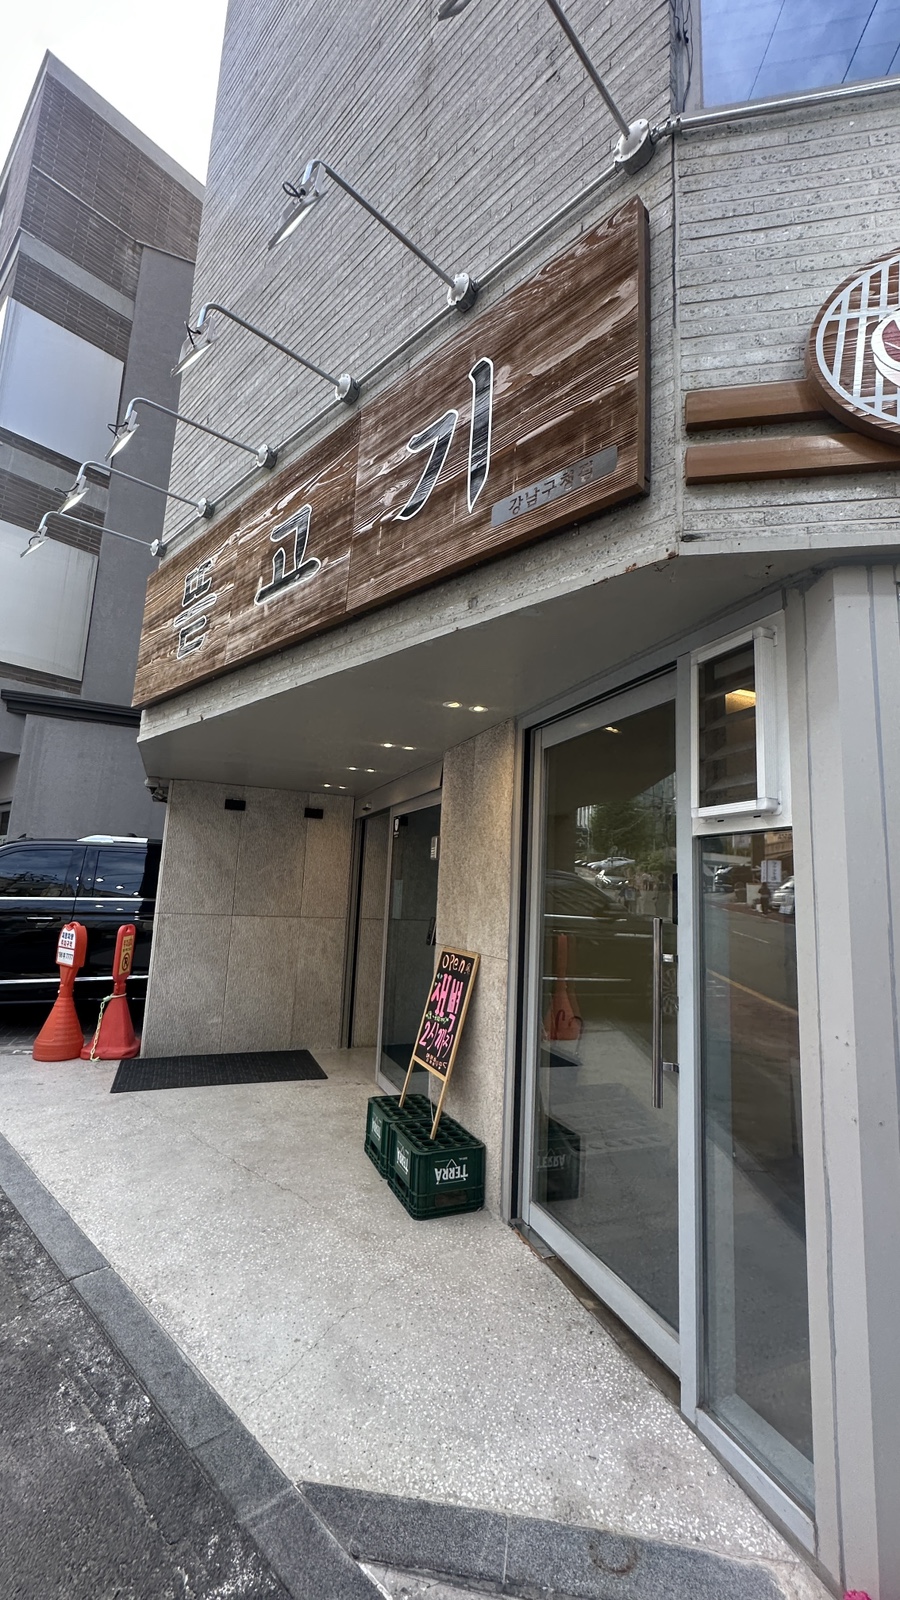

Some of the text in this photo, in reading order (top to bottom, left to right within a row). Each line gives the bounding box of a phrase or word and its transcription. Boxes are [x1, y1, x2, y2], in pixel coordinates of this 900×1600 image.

[508, 459, 594, 516] 강남구청점
[430, 973, 464, 1033] 새벽
[418, 1021, 454, 1058] 2시까지
[434, 1163, 469, 1185] TERRA
